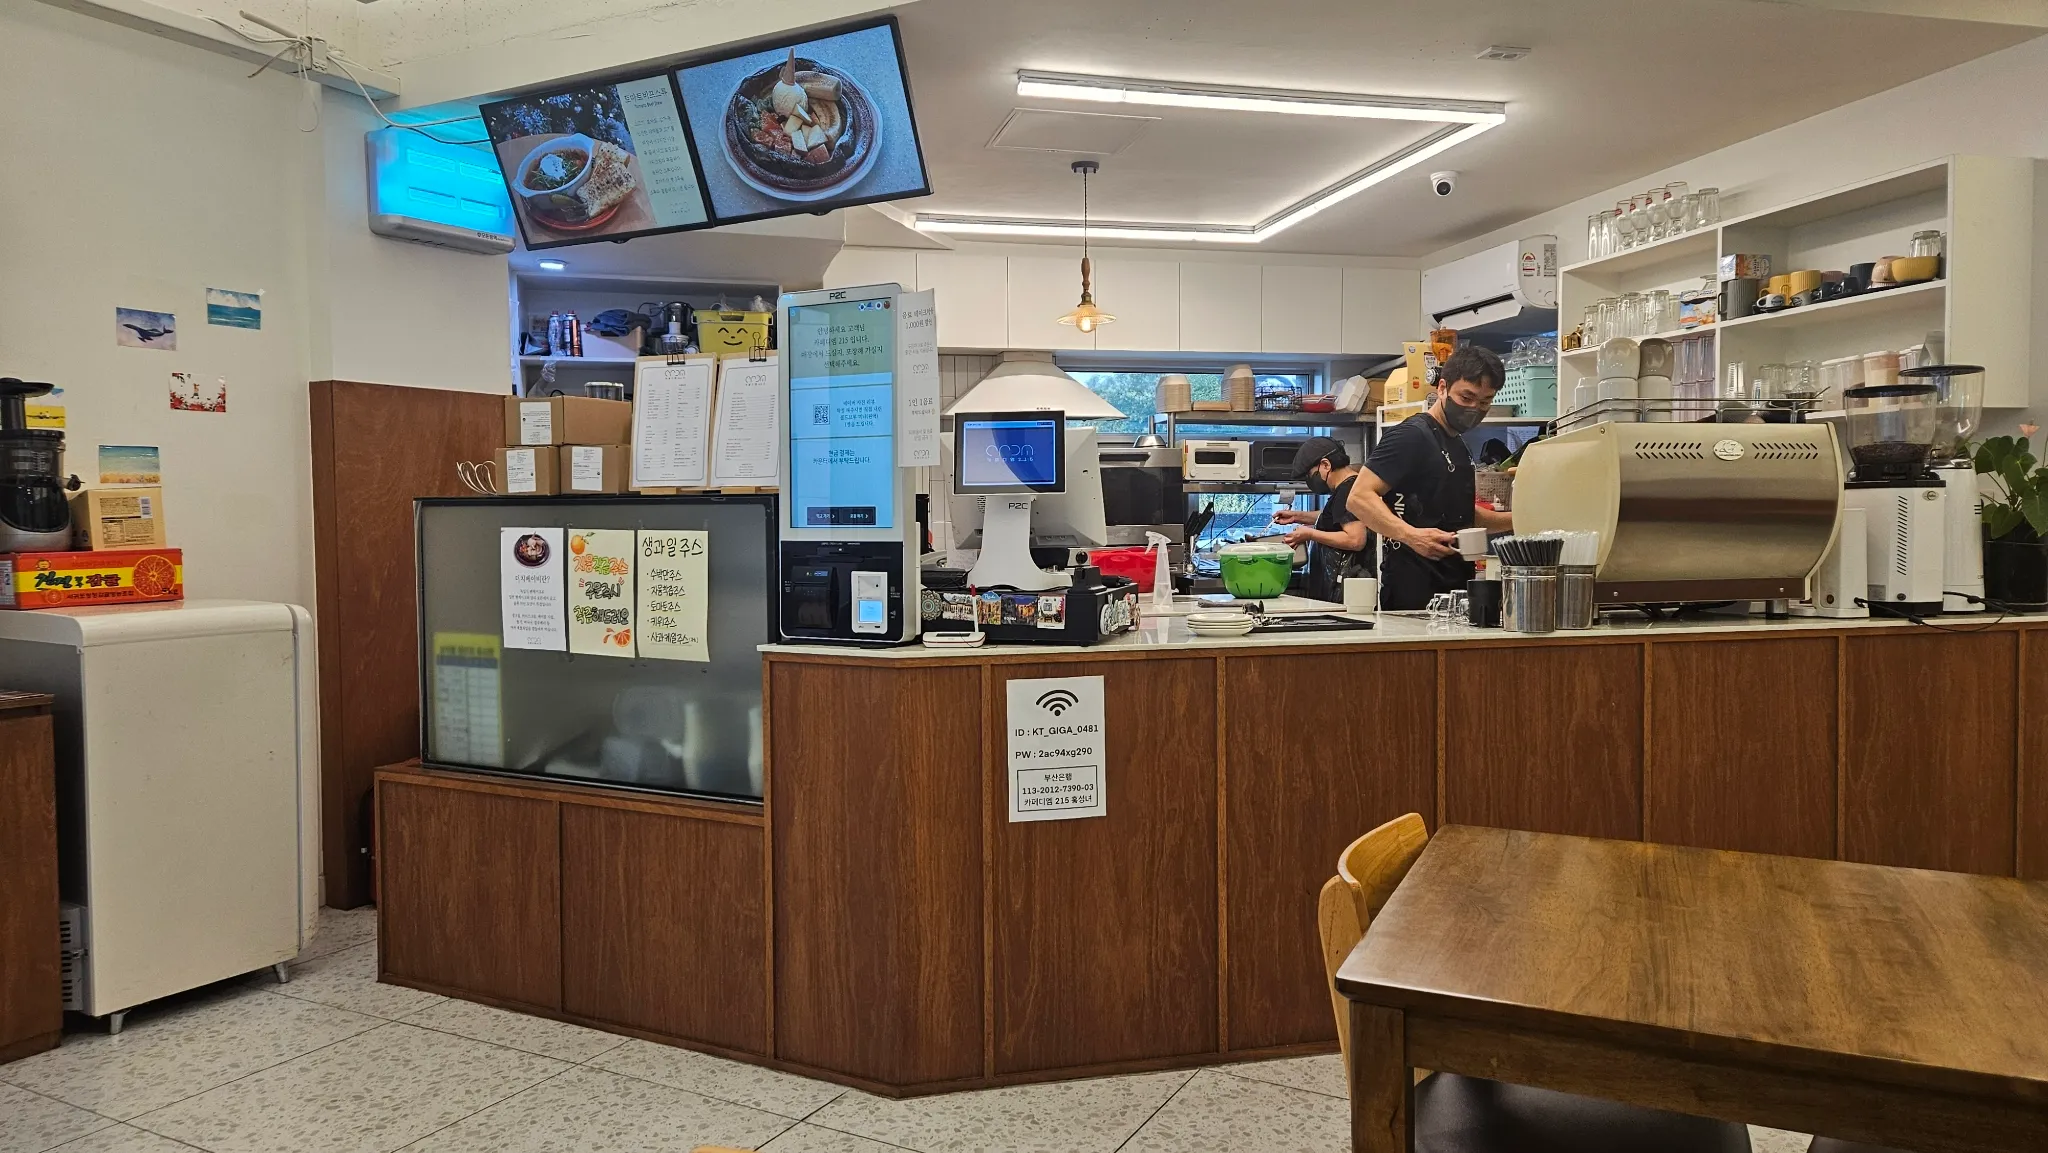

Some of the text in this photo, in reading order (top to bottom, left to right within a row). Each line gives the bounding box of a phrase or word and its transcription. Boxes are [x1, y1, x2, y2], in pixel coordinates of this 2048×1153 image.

[829, 291, 846, 300] P2C
[817, 324, 865, 335] 안녕하세요 고객님
[905, 320, 924, 329] 1,000원
[850, 335, 870, 343] 입니다.
[801, 350, 824, 359] 매장에서
[846, 348, 863, 356] 포장해
[865, 346, 883, 354] 가실지
[824, 359, 860, 368] 선택해주세요.
[908, 398, 933, 406] 1인 1음료
[1009, 502, 1028, 510] P2C
[642, 537, 703, 558] 생과일 주스
[573, 554, 628, 575] 자몽착즙주스
[86, 574, 121, 587] 감귤
[585, 581, 621, 599] 주문즉시
[650, 585, 686, 597] 자몽착즙주스
[650, 600, 681, 612] 토마토주스
[573, 605, 629, 625] 착즙해드려요
[650, 616, 677, 628] 키위주스
[1015, 728, 1025, 737] ID
[1032, 724, 1099, 738] KT_GIGA_0481
[1015, 751, 1031, 759] PW
[1038, 747, 1093, 759] 2ac94xg290
[1044, 773, 1072, 782] 부산은행
[1022, 784, 1094, 795] 113-2012-7390-03
[1024, 797, 1053, 806] 카페디엠
[1055, 796, 1069, 804] 215
